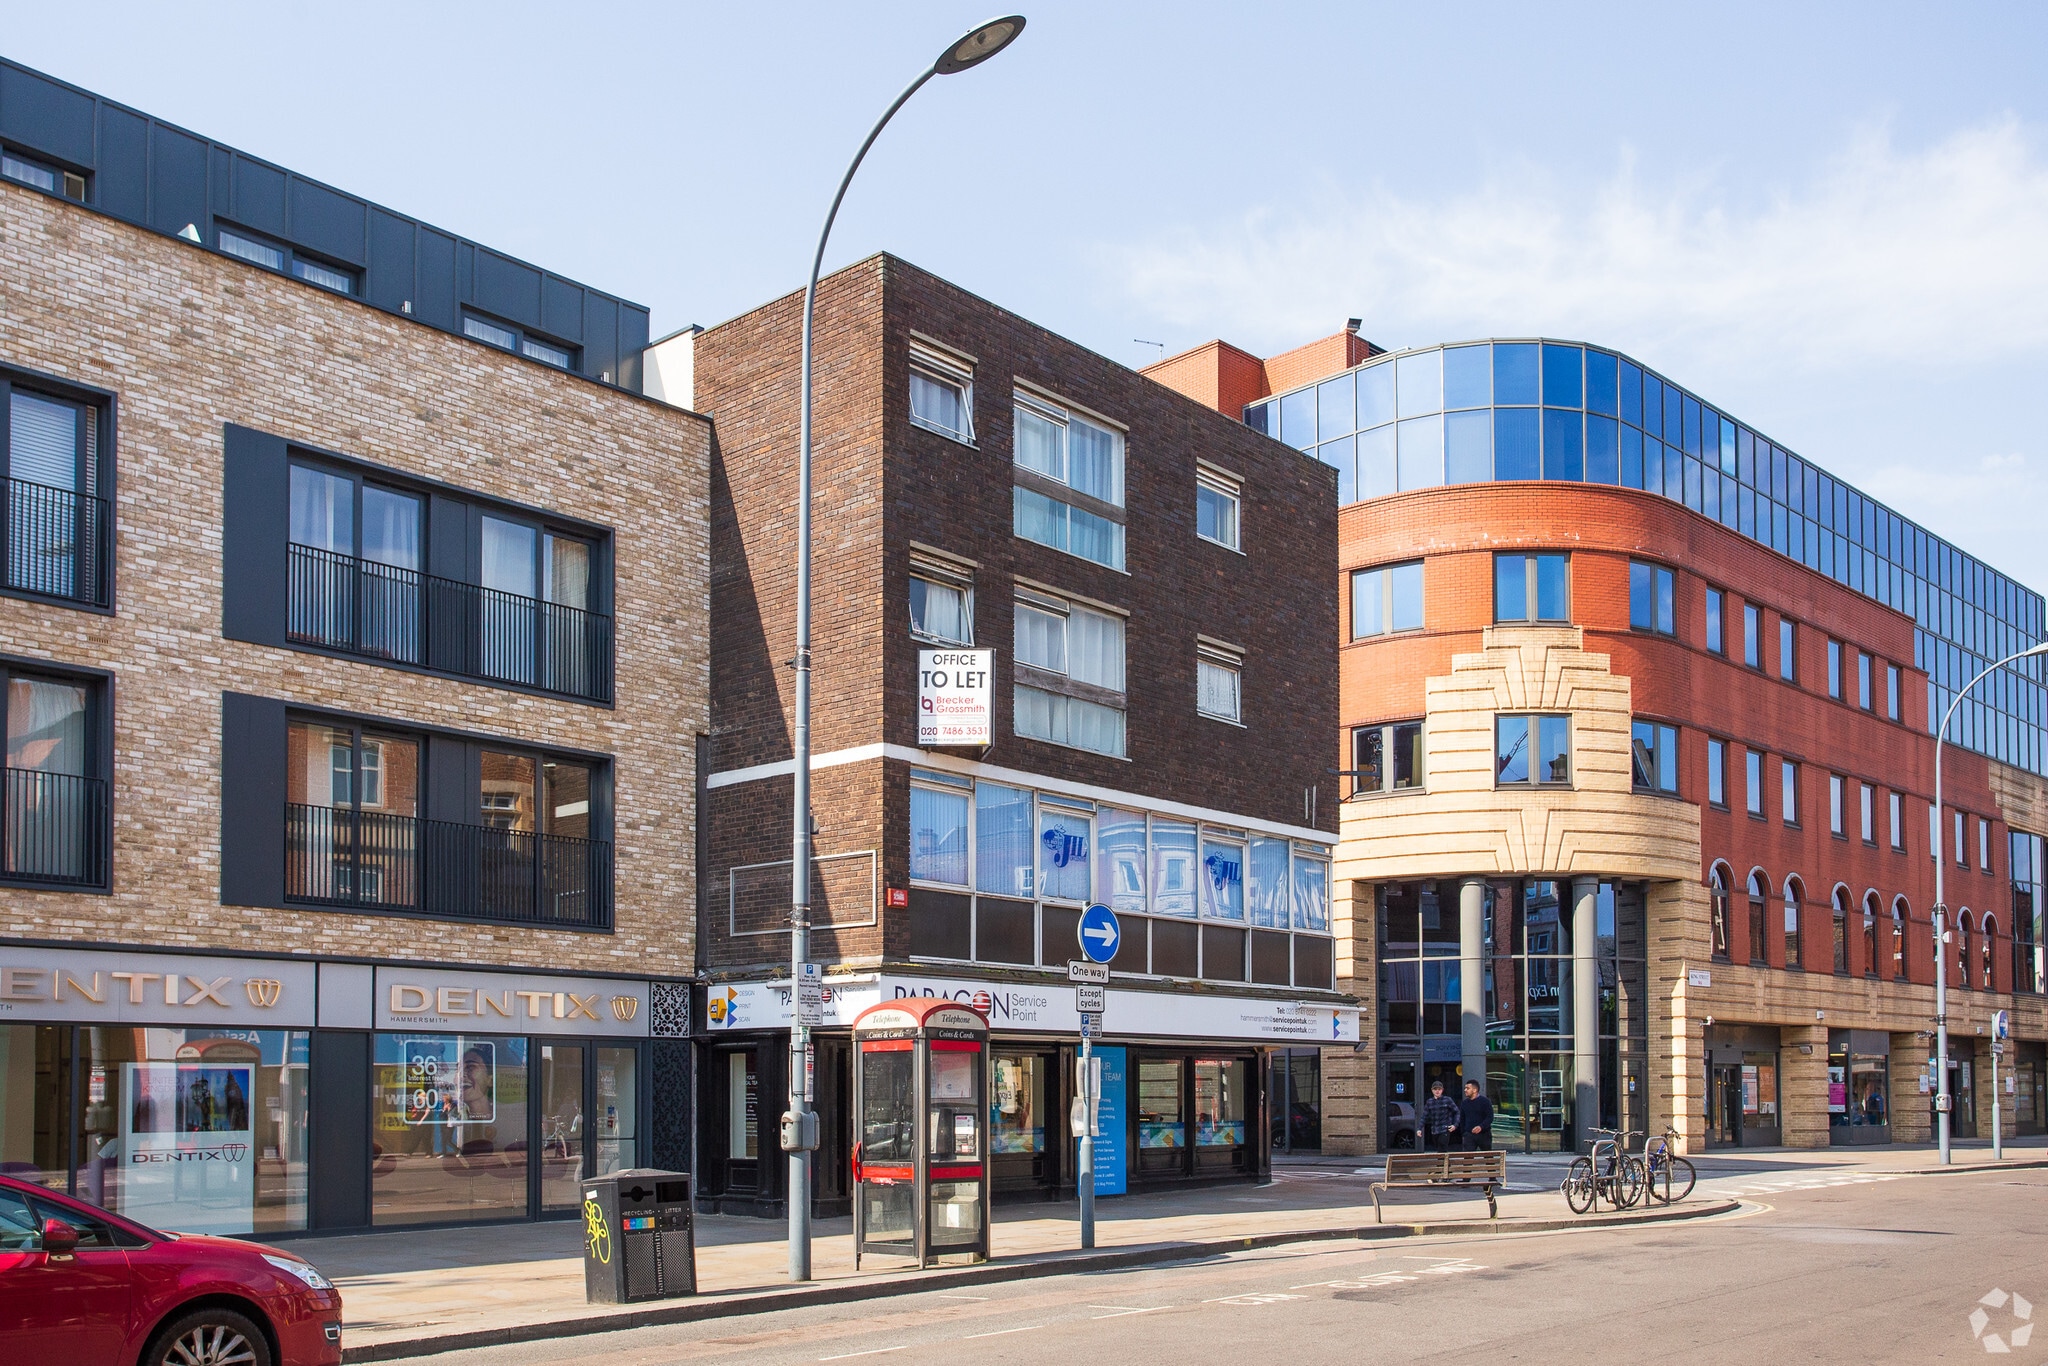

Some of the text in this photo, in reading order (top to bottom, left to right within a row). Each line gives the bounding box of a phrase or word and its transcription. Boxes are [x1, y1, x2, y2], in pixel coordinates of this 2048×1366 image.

[932, 654, 976, 666] OFFICE
[921, 671, 986, 688] TO LET
[936, 696, 975, 705] Brecker
[936, 705, 985, 713] Grossmith
[921, 727, 987, 735] 020 7486 3531
[1072, 965, 1106, 979] One way
[0, 967, 231, 1006] ENTIX
[1080, 989, 1102, 999] Except
[390, 984, 603, 1021] DENTIX
[1012, 993, 1047, 1008] Service
[1080, 1000, 1101, 1008] cycles
[390, 1016, 448, 1024] HAMMERSMITH
[872, 1014, 902, 1024] Telephone
[941, 1013, 971, 1025] Telephone
[1012, 1008, 1037, 1022] Point
[889, 1030, 904, 1038] Cards
[938, 1030, 953, 1038] Coins
[959, 1031, 974, 1039] Cards
[411, 1055, 438, 1076] 36
[147, 1076, 181, 1085] UNITED
[1104, 1072, 1122, 1081] TEAM
[142, 1085, 185, 1093] KINGDOM
[413, 1089, 438, 1109] 60
[132, 1151, 220, 1163] DENTIX
[624, 1209, 653, 1217] RECYCLING
